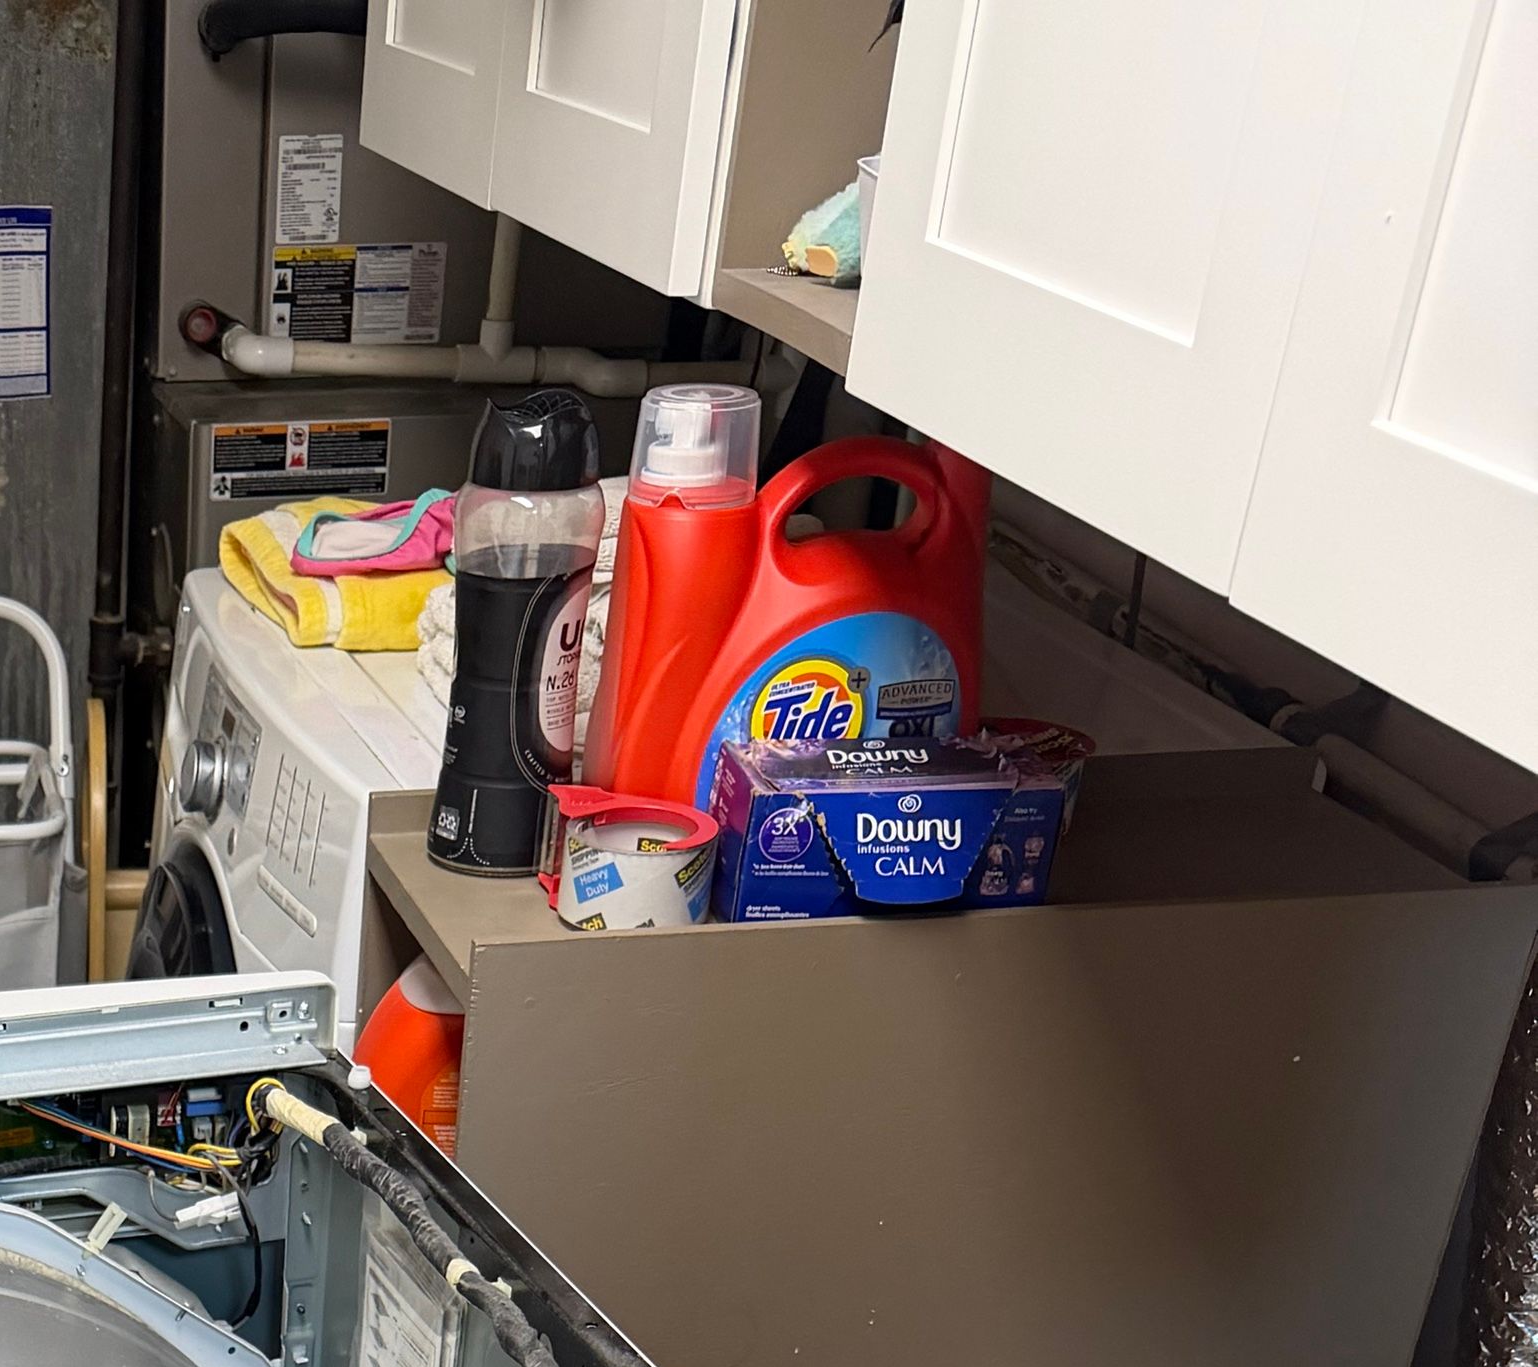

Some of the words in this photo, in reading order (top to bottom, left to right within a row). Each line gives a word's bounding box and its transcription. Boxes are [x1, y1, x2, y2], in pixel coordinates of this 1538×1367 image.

[769, 682, 815, 697] CONCENTRATED
[771, 681, 790, 690] ULTRA
[882, 682, 952, 700] ADVANCED
[764, 690, 853, 739] Tide
[889, 715, 935, 737] OXI
[524, 750, 546, 776] CRAFTED
[826, 749, 929, 764] Downy
[857, 813, 961, 850] Downy
[640, 840, 667, 852] Sco
[857, 844, 910, 855] infusions
[875, 857, 945, 876] CALM
[580, 869, 608, 886] Heavy
[586, 882, 609, 898] Duty
